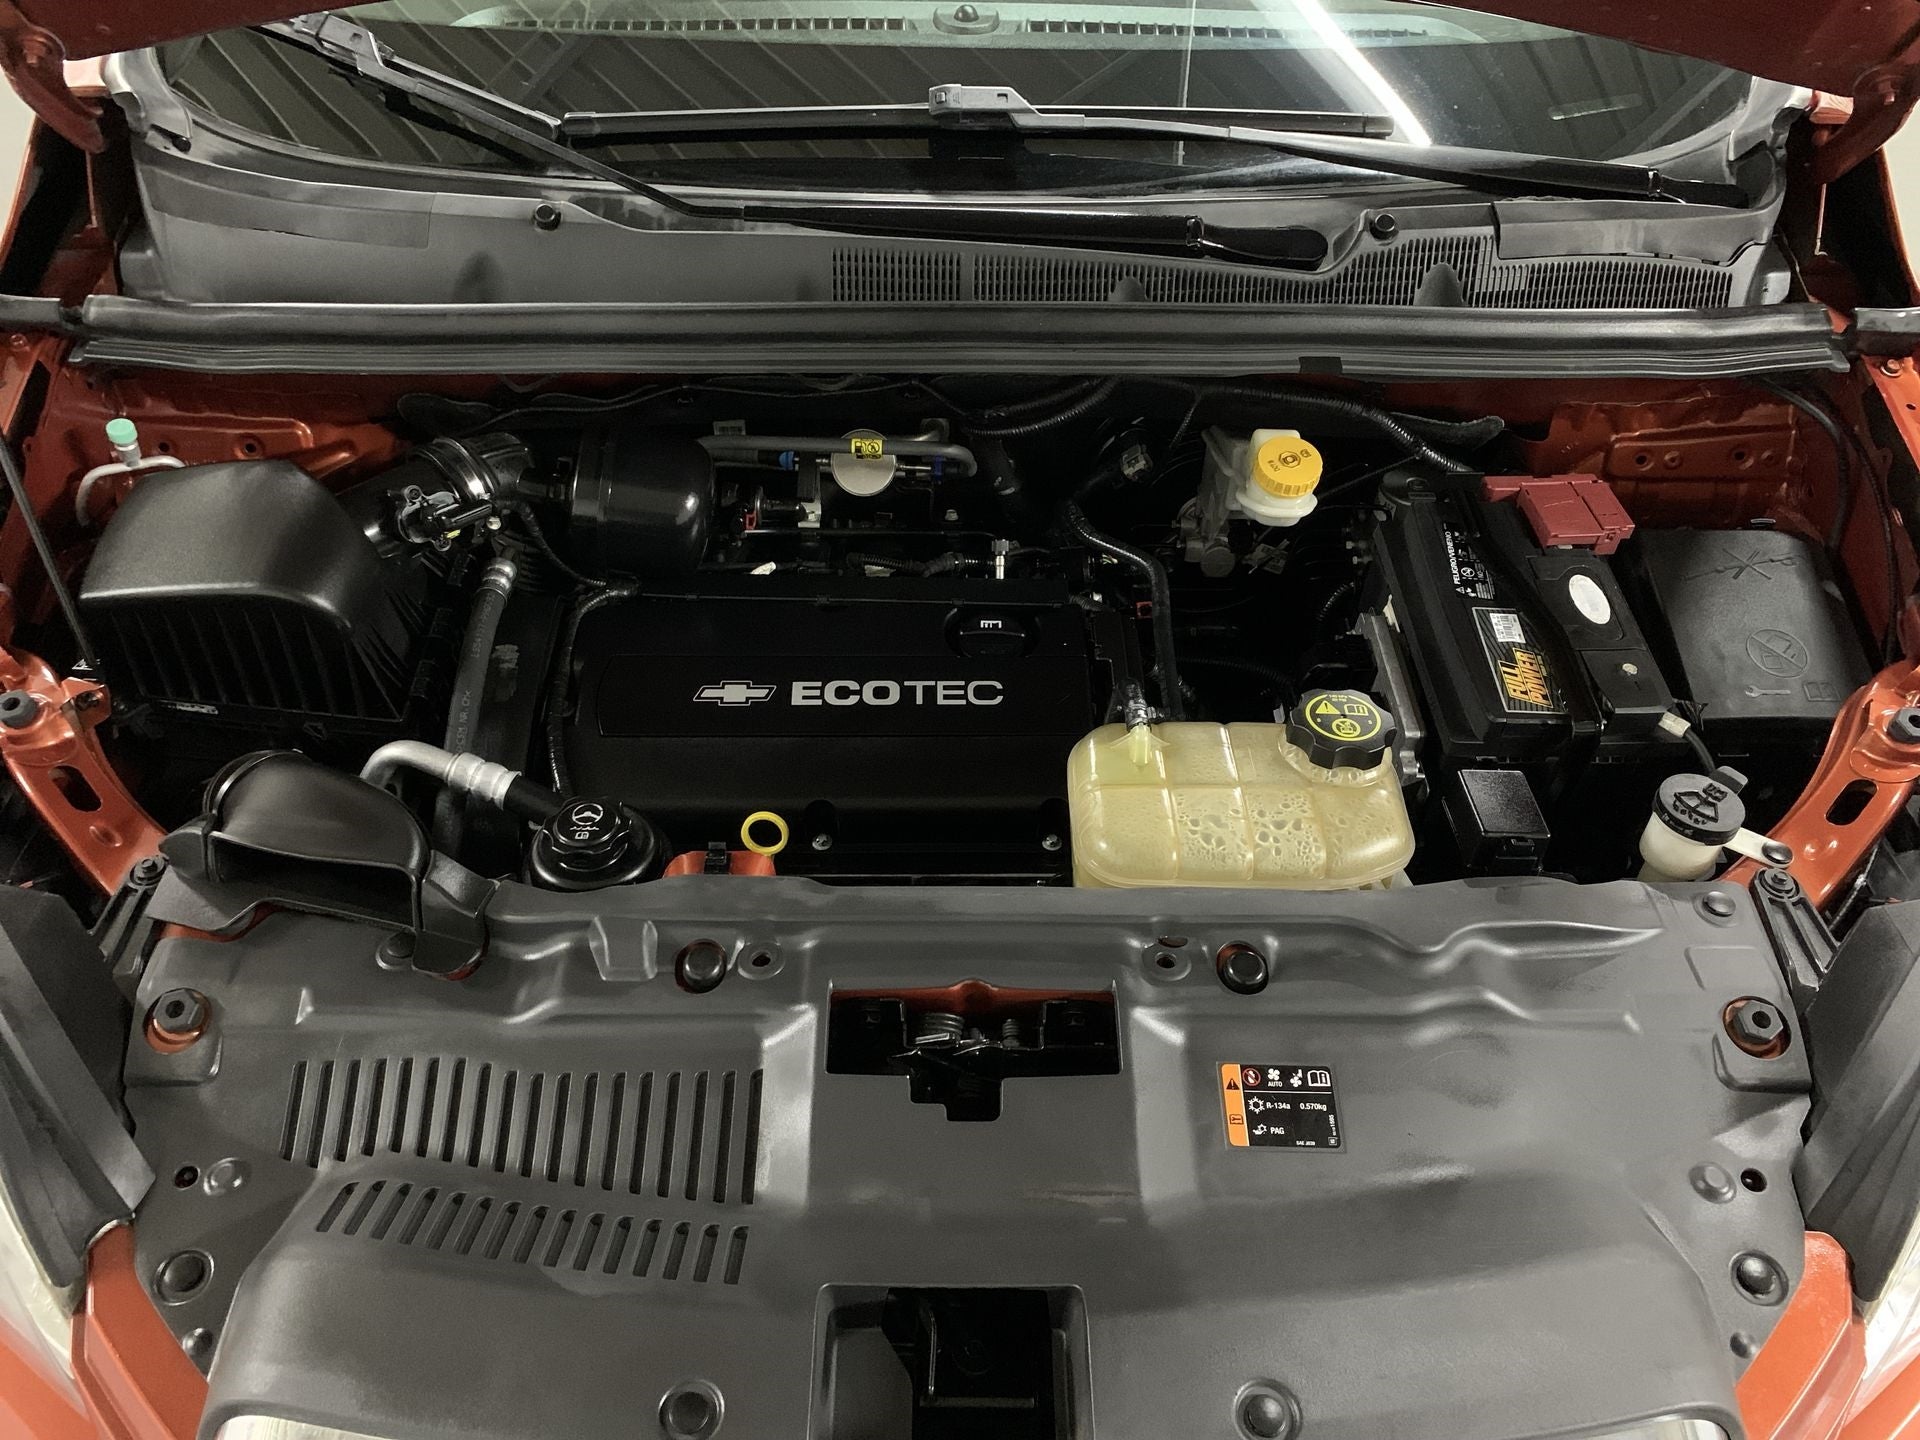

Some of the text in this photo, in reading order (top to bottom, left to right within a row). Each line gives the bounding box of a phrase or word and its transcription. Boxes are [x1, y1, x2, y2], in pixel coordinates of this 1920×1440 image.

[1500, 661, 1530, 700] FULL
[1515, 650, 1551, 705] POWER
[791, 680, 1003, 706] ECOTEC
[1266, 1102, 1327, 1111] R-134a 0.570kg
[1270, 1127, 1285, 1135] PAG
